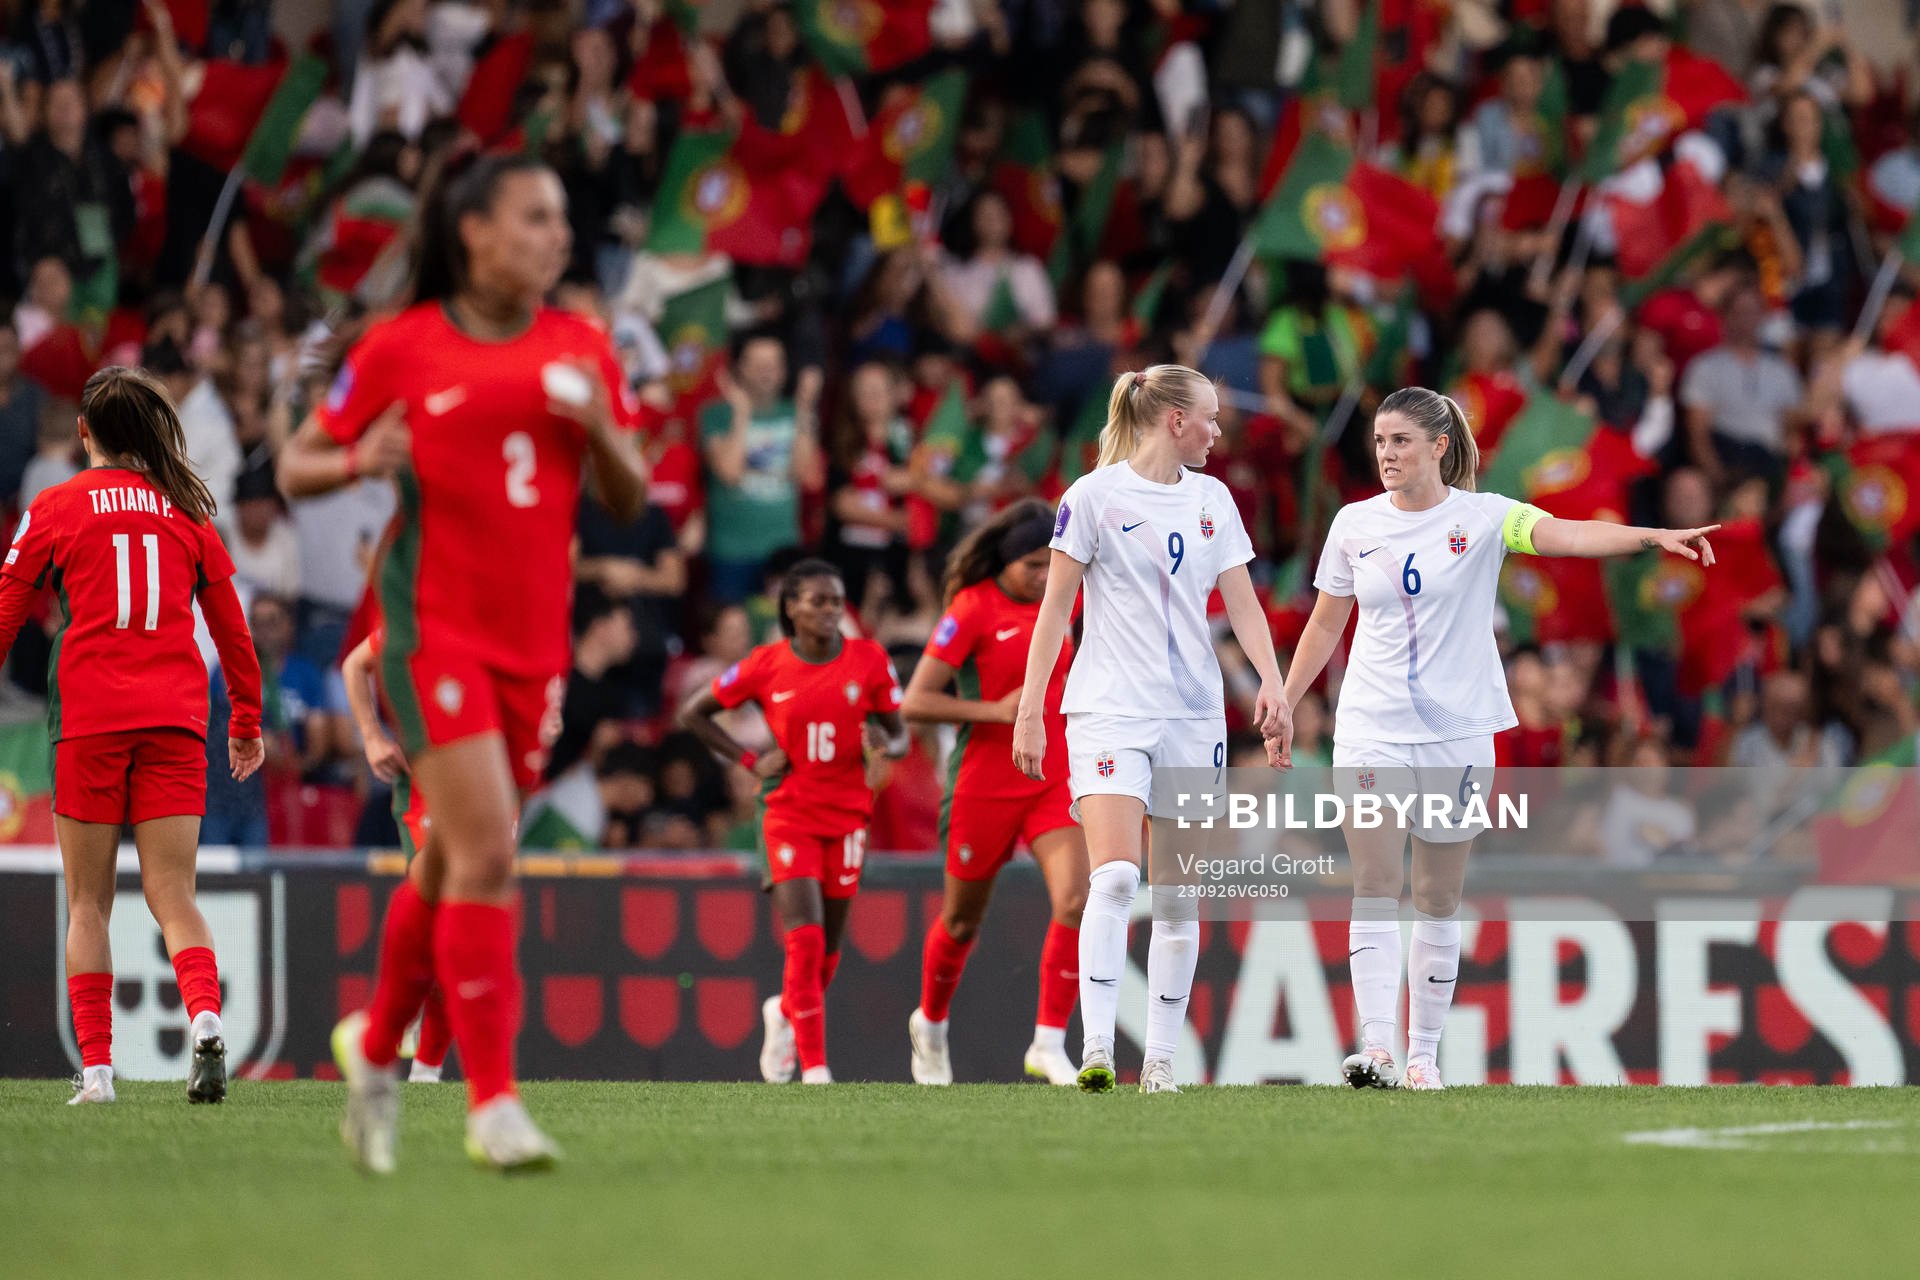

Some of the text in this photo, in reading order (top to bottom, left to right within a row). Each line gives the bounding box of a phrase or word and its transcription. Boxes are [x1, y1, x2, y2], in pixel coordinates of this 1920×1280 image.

[501, 430, 541, 509] 2
[88, 486, 159, 515] TATIANA
[1167, 531, 1184, 575] 9
[1402, 552, 1422, 596] 6
[112, 533, 160, 630] 11
[806, 721, 836, 763] 16
[1213, 741, 1224, 785] 9
[1458, 765, 1476, 808] 6
